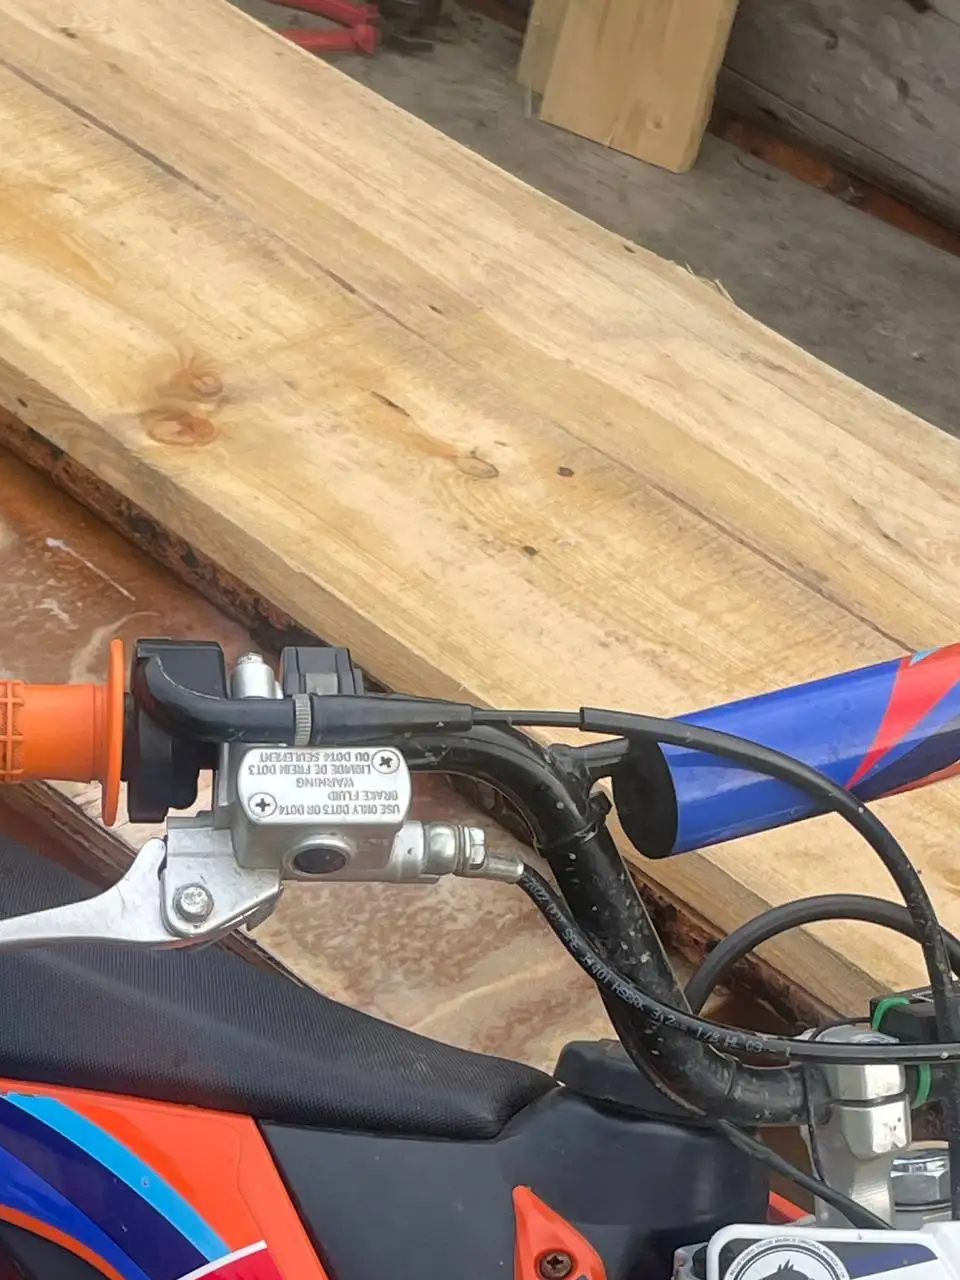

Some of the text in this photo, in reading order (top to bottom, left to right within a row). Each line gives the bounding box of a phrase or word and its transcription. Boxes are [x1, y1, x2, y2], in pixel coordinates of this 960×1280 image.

[323, 752, 351, 762] DOT4
[355, 752, 370, 762] OU
[280, 764, 311, 774] FREIN
[314, 764, 328, 775] DE
[295, 777, 354, 788] WARNING
[327, 790, 398, 801] BRAKE FLUID
[278, 804, 304, 815] DOT4
[307, 804, 321, 815] OR
[351, 804, 377, 815] ONLY
[380, 804, 400, 815] USE
